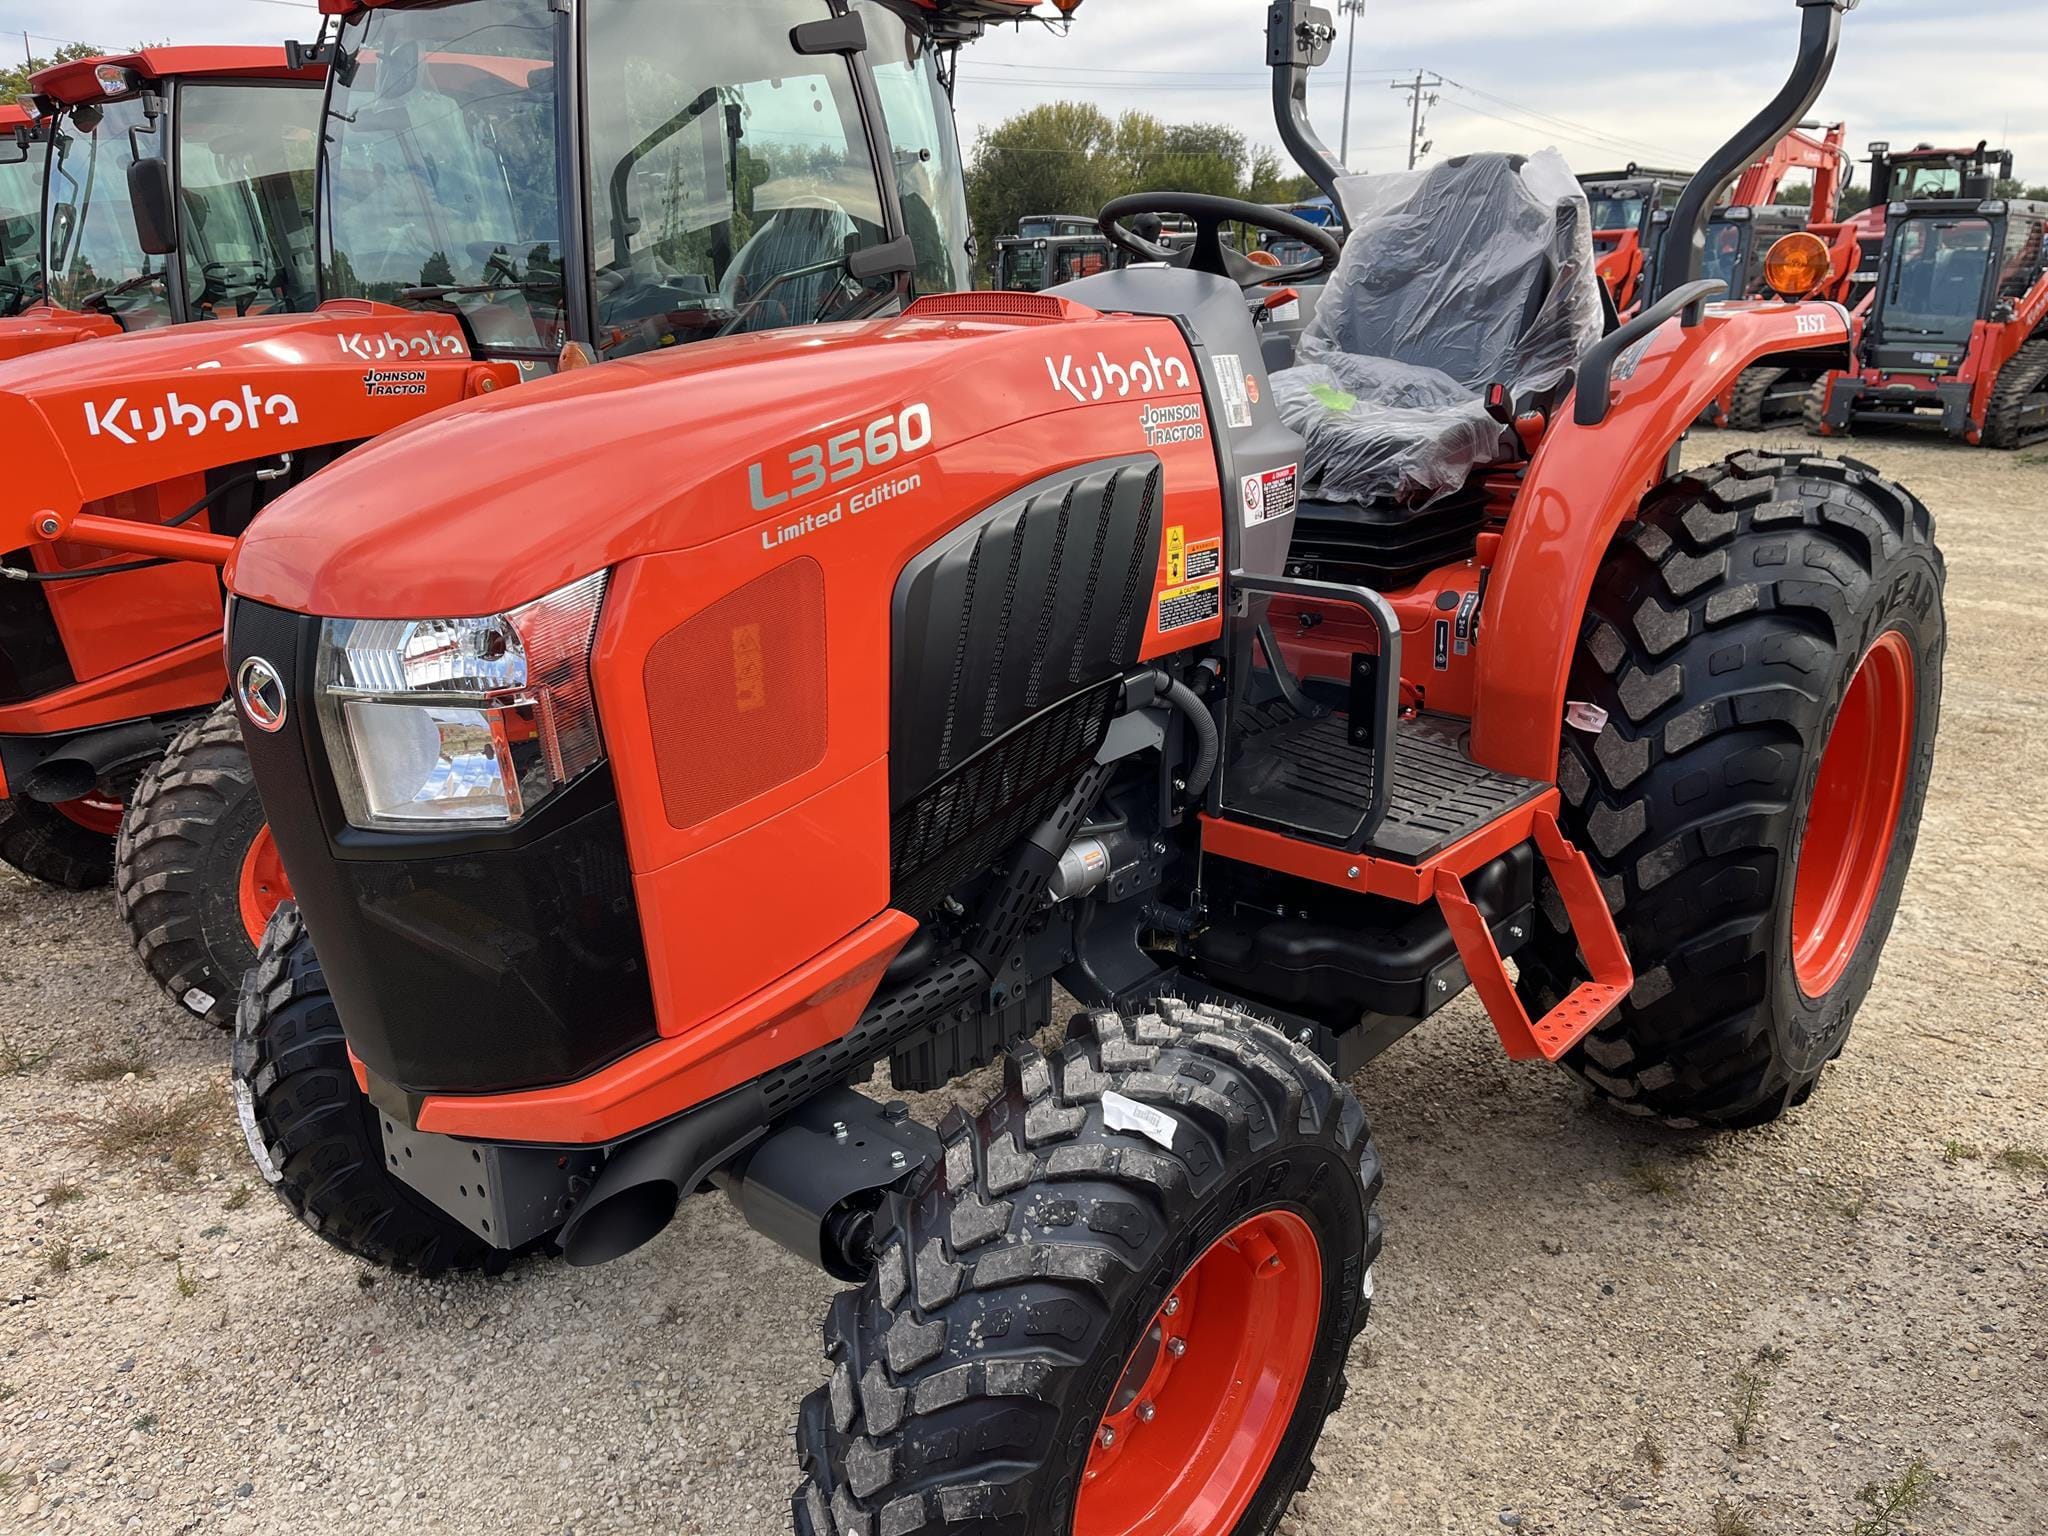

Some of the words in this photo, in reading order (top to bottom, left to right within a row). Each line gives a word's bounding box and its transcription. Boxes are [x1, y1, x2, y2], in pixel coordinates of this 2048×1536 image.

[336, 329, 464, 360] Kubota
[1795, 314, 1826, 334] HST
[1044, 346, 1190, 402] Kubota
[83, 384, 299, 444] Kubota
[748, 402, 932, 511] L3560
[762, 503, 842, 550] Limited
[849, 474, 921, 514] Edition
